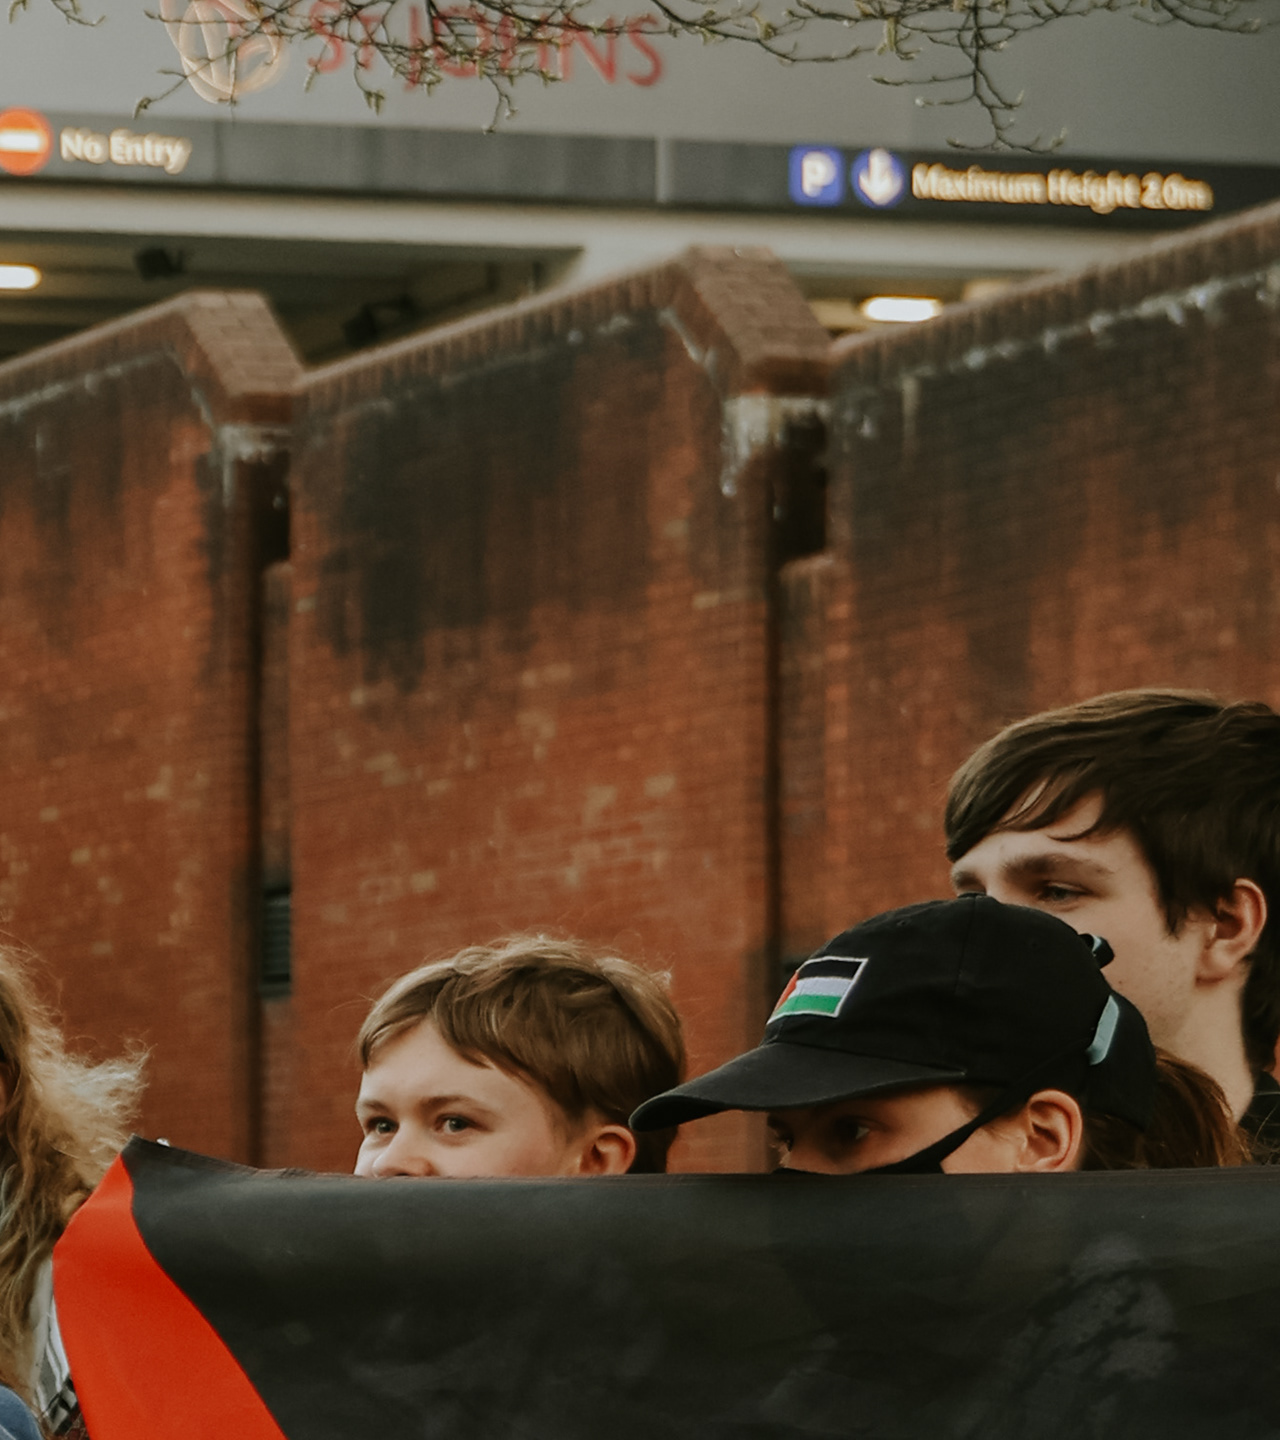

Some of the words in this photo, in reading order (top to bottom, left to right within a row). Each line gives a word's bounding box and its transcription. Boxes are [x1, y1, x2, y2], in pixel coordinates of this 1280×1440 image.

[60, 127, 109, 164] No
[110, 128, 192, 174] Entry
[801, 151, 837, 197] P
[912, 162, 1048, 204] Maximum
[1048, 168, 1140, 214] Height
